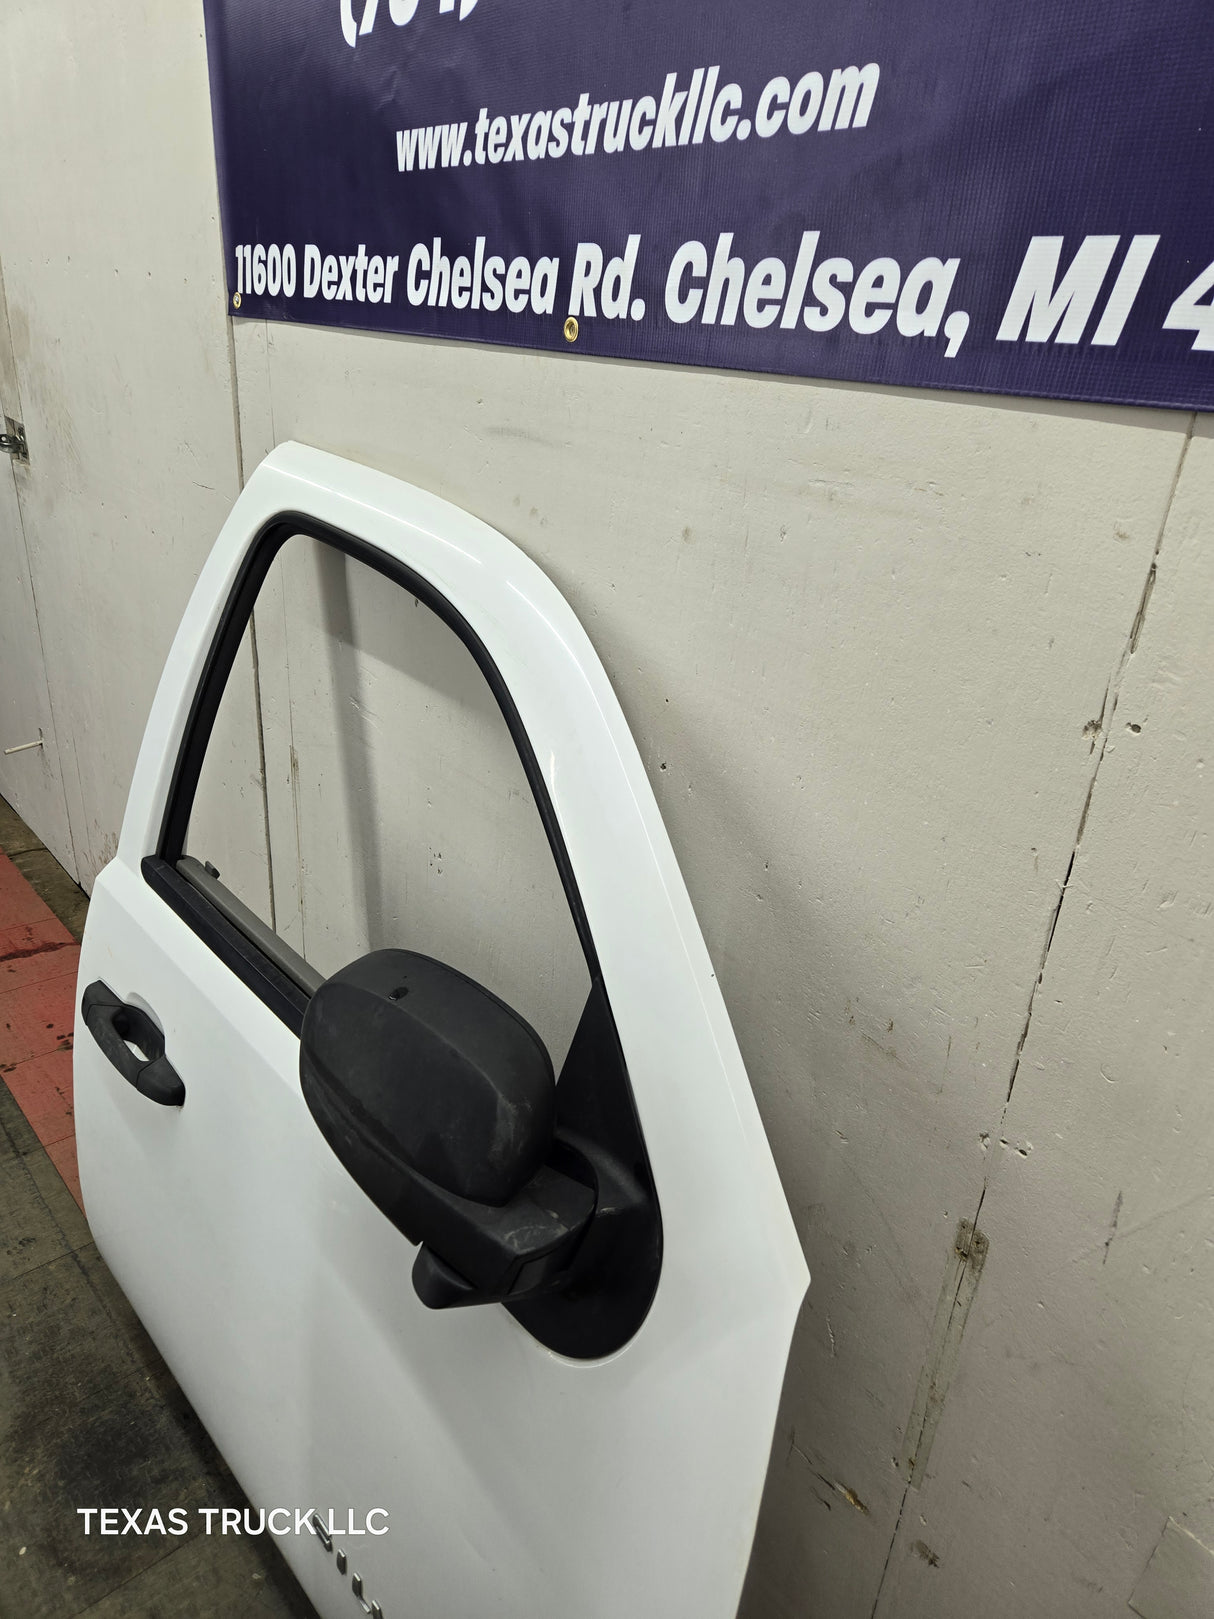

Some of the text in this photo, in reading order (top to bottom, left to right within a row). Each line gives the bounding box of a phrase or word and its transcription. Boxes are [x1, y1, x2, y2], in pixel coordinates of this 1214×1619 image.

[396, 62, 881, 172] www.texastruckllc.com
[235, 243, 297, 298] 11600
[303, 244, 399, 304] Dexter
[407, 236, 560, 315] Chelsea
[567, 233, 646, 322] Rd.
[664, 230, 970, 359] Chelsea,
[995, 234, 1161, 346] MI
